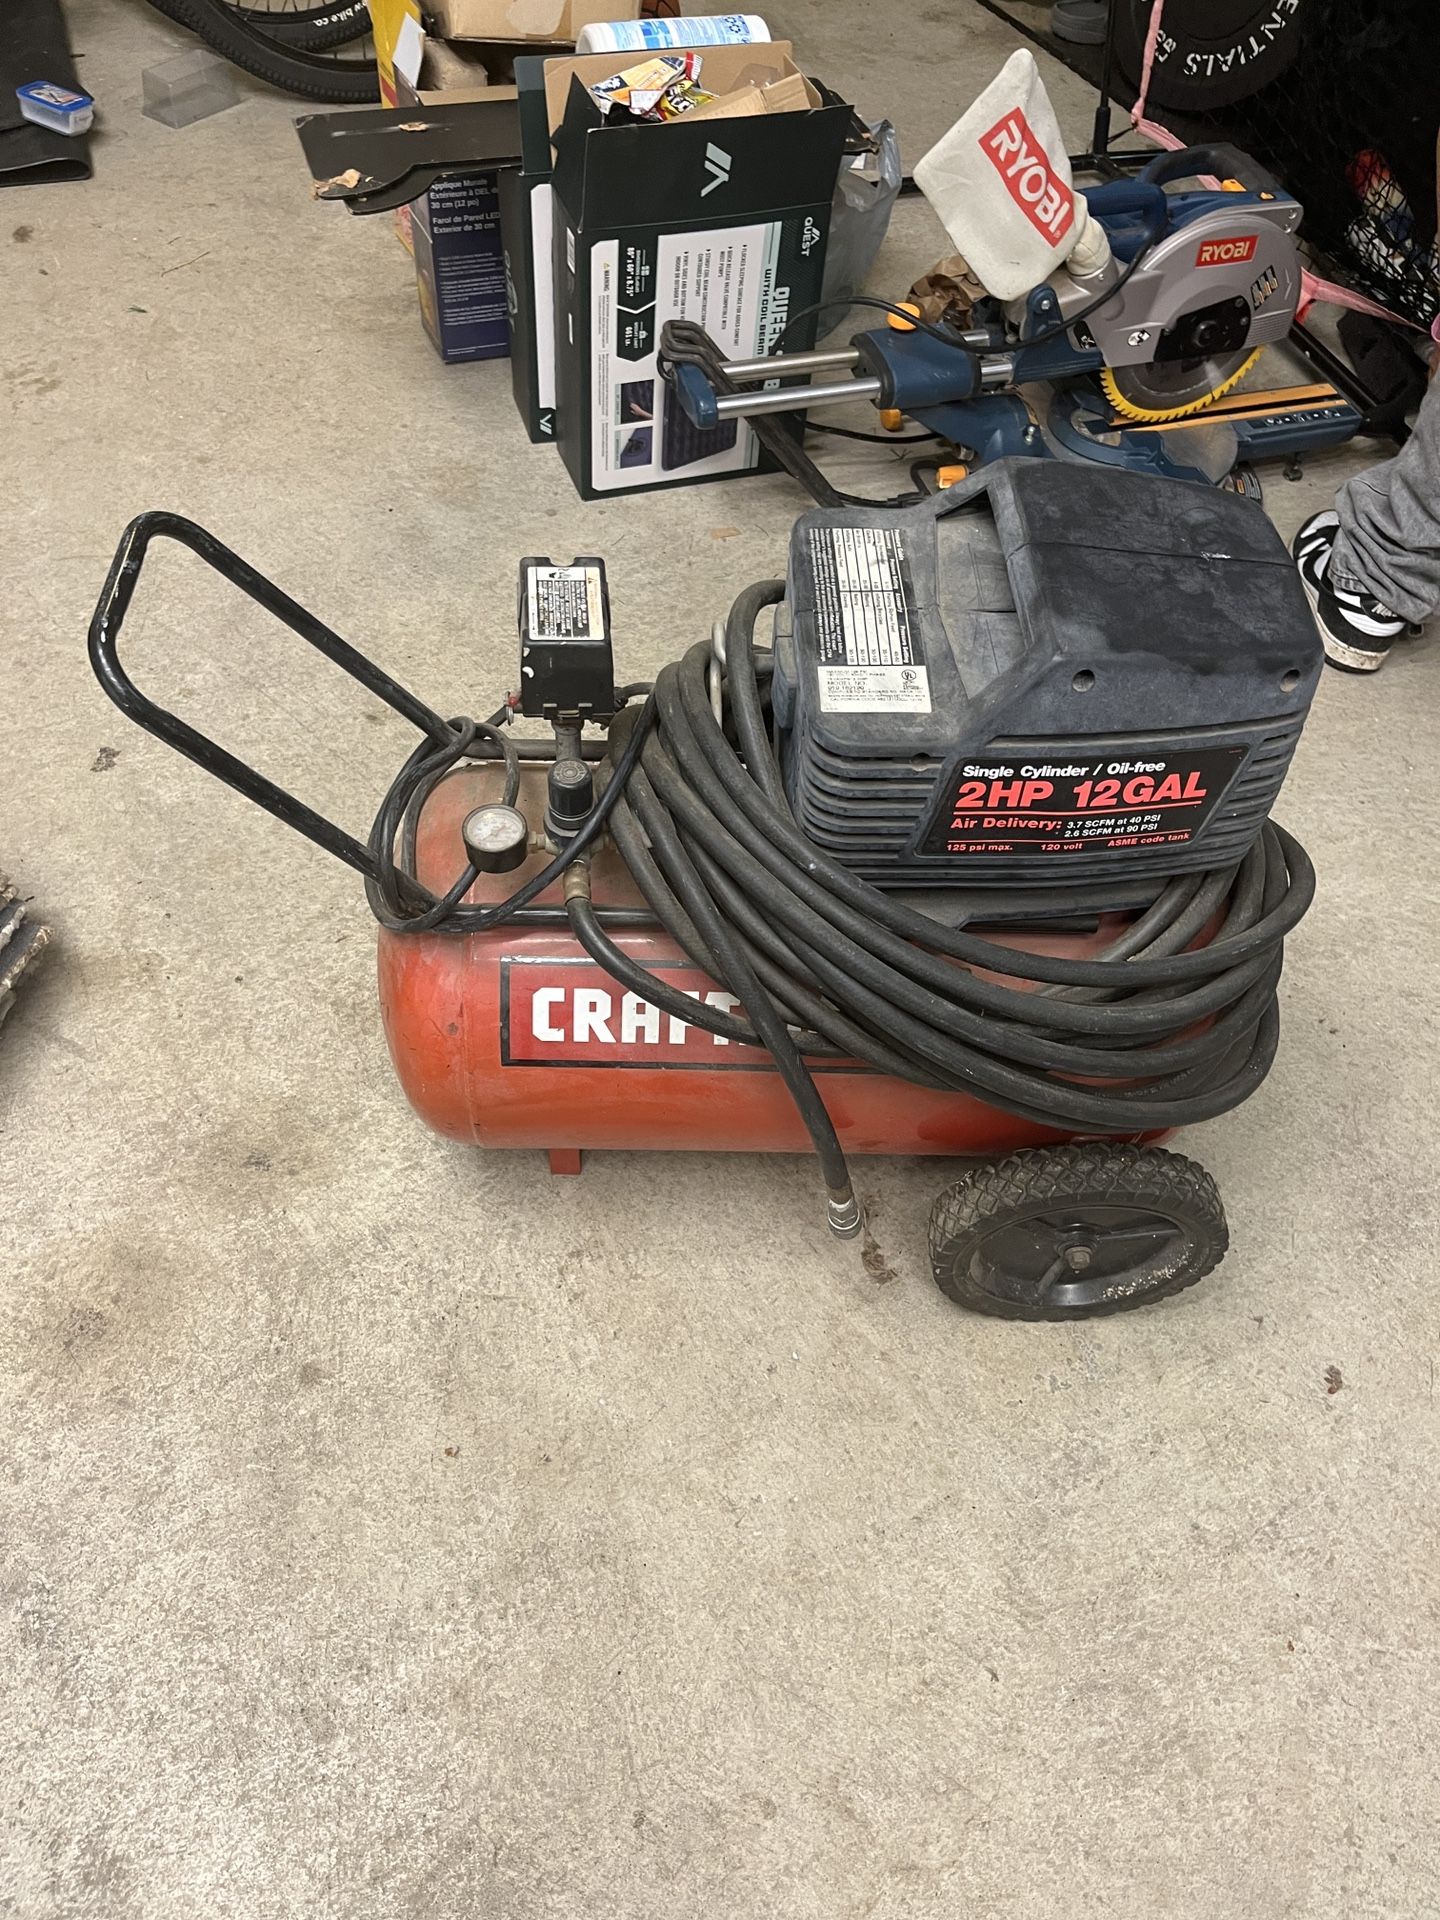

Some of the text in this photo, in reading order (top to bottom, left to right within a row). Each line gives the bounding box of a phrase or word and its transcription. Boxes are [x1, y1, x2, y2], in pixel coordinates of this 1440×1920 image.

[331, 8, 354, 22] bike
[990, 120, 1071, 233] RYOBI
[801, 216, 814, 257] QUEST
[1201, 241, 1250, 262] RYOBI
[757, 268, 772, 355] WITH COIL BEAM
[899, 625, 907, 645] Pressure
[962, 760, 1166, 779] Single Cylinder / Oil-free
[955, 771, 1208, 808] 2HP 12GAL
[950, 817, 1063, 832] Air Delivery:
[1067, 814, 1162, 830] 3.7 SCFM at 40 PSI
[1082, 827, 1113, 838] SCFM
[1114, 826, 1125, 835] at
[1127, 824, 1140, 834] 90
[1140, 822, 1158, 832] PSI
[947, 843, 1014, 852] 125 psi max.
[1041, 842, 1084, 851] 120 volt
[1107, 833, 1190, 848] ASME code tank
[532, 986, 741, 1046] CRAFT
